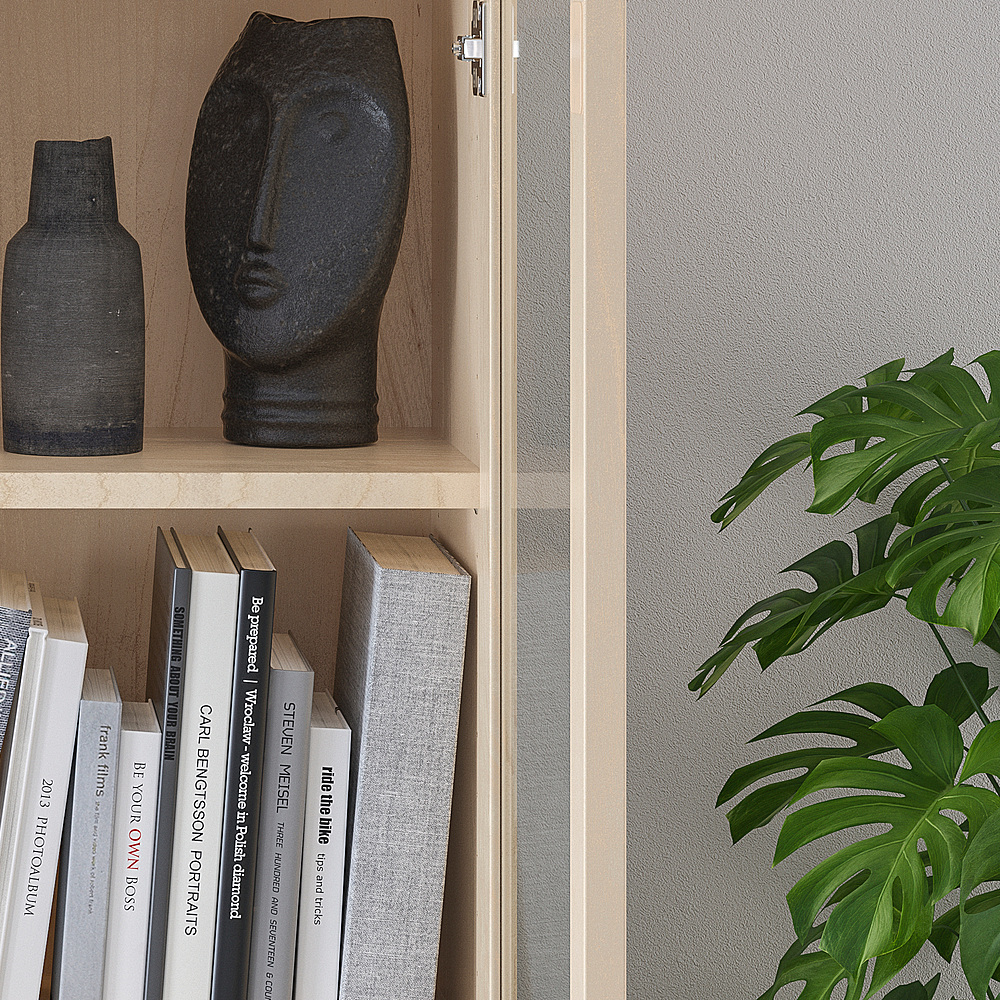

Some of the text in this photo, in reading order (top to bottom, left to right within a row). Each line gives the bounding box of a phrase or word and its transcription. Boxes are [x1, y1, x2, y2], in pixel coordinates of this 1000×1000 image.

[249, 596, 263, 612] Be
[244, 616, 262, 672] prepared
[165, 606, 185, 761] SOMETHING ABOUT YOUR BRAIN
[280, 702, 295, 755] STEVEN
[94, 725, 111, 796] frank films
[236, 753, 250, 809] welcome
[277, 764, 293, 813] MEISEL
[185, 704, 212, 936] CARL BENGTSSON PORTRAITS
[237, 811, 248, 823] in
[276, 822, 284, 848] THREE
[24, 779, 54, 916] 2013 PHOTOALBUM
[126, 828, 142, 871] OWN
[234, 825, 248, 861] Polish
[313, 766, 335, 925] ride the bike tips and tricks
[229, 864, 246, 919] diamond
[272, 852, 283, 893] HUNDRED
[271, 897, 279, 915] AND
[267, 919, 278, 968] SEVENTEEN
